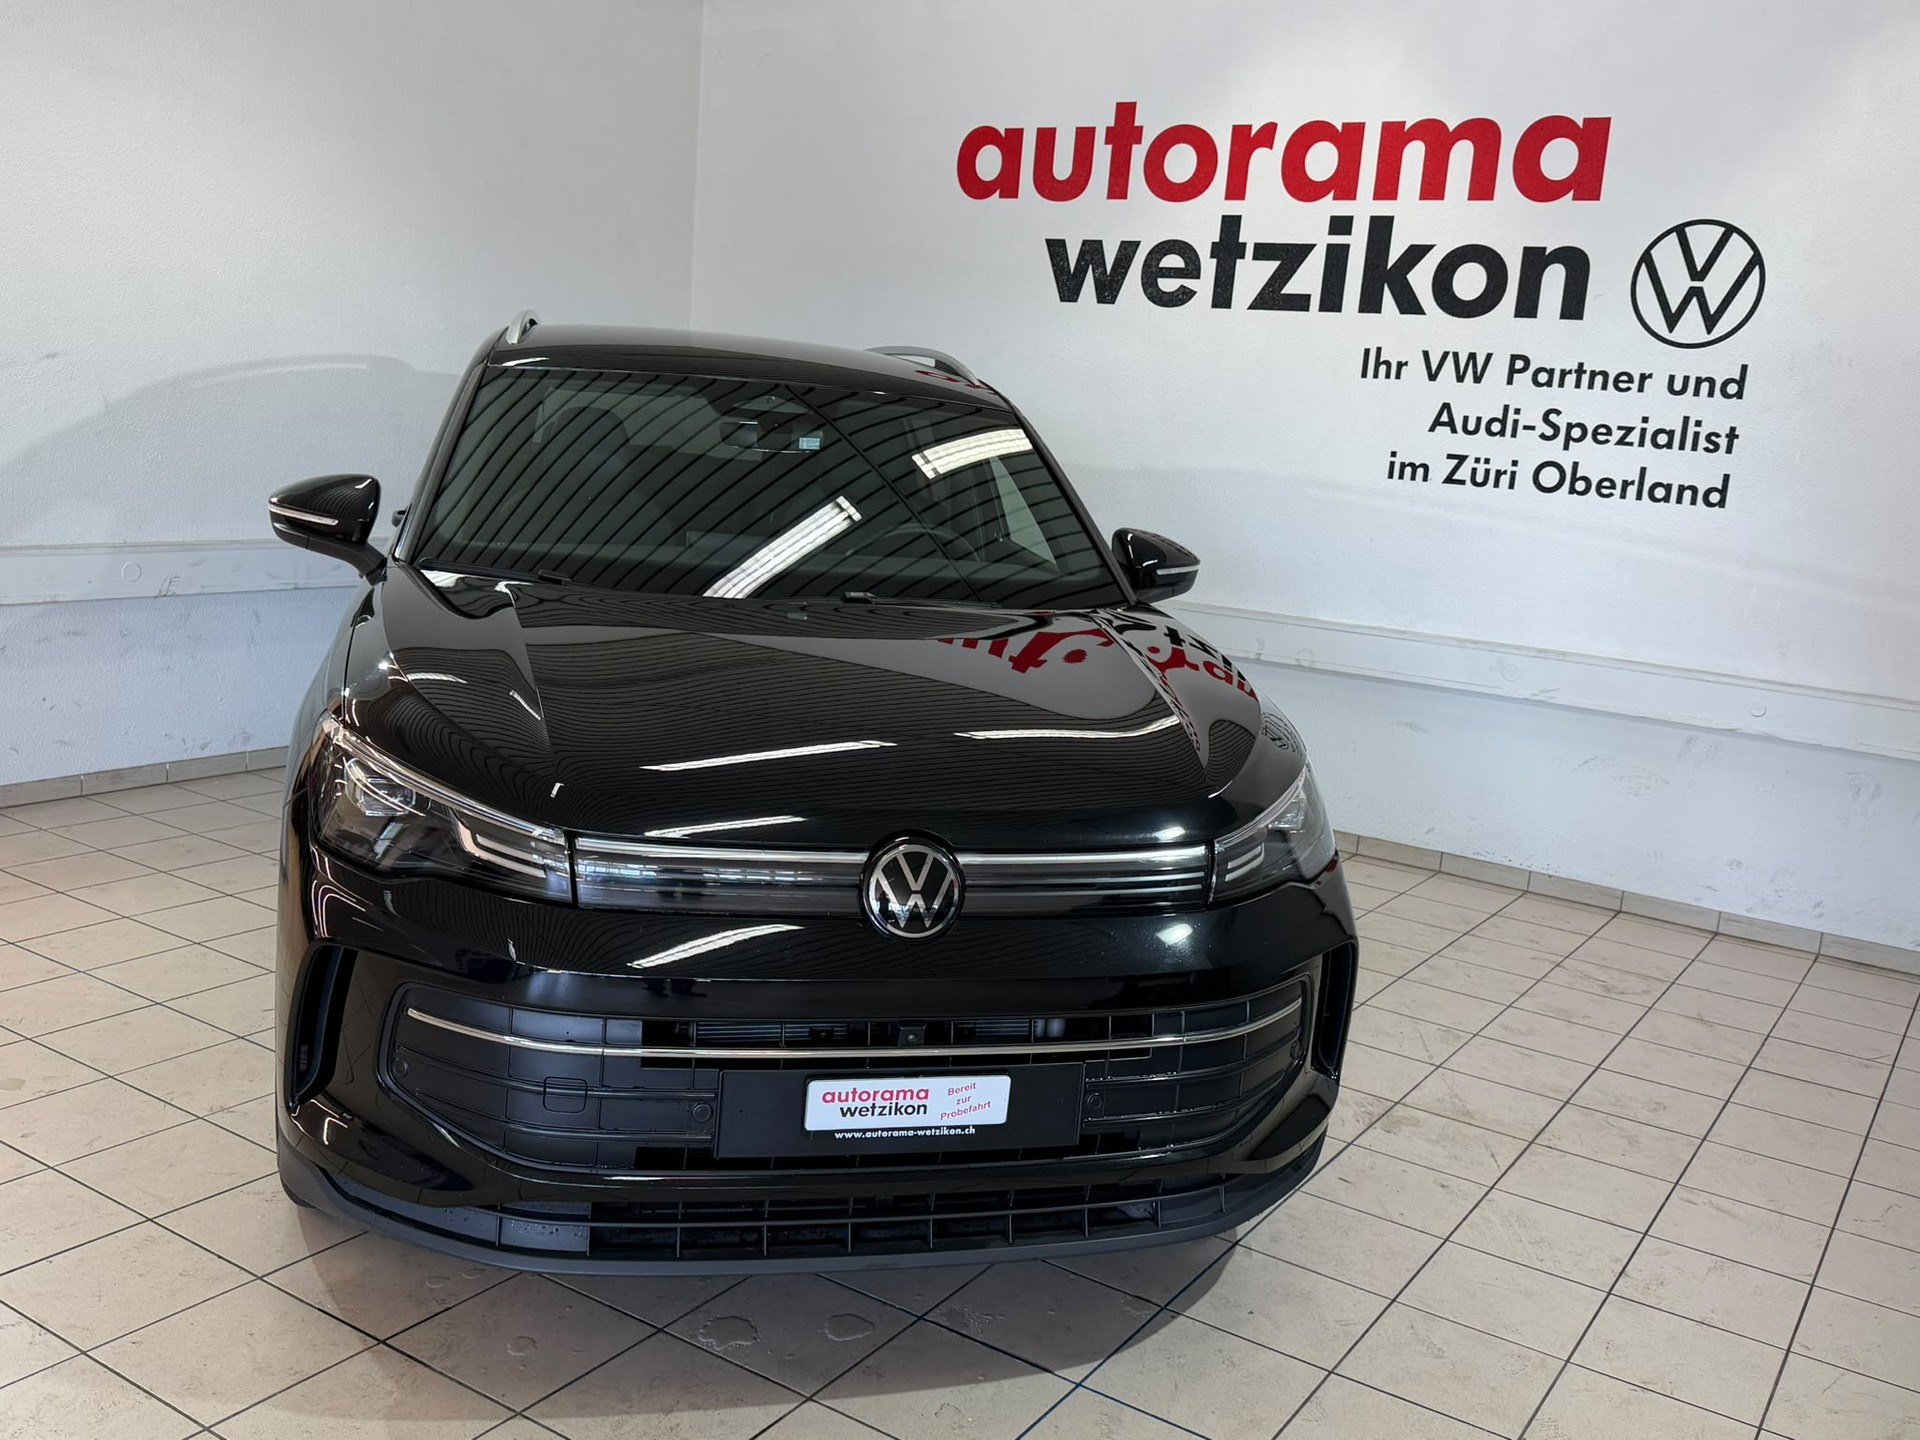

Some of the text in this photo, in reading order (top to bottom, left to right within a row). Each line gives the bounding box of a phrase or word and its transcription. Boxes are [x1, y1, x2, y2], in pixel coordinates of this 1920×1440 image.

[958, 102, 1611, 203] autorama
[1045, 215, 1590, 320] wetzikon
[1361, 347, 1748, 400] Ihr VW Partner und
[1428, 403, 1739, 454] Audi-Spezialist
[1388, 451, 1730, 508] im Züri Oberland
[822, 1087, 929, 1104] autorama
[947, 1082, 976, 1096] Bereit
[840, 1102, 927, 1118] wetzikon
[956, 1095, 972, 1105] zur
[940, 1101, 991, 1121] Probefahrt
[834, 1125, 976, 1139] www.autorama-wetzikon.ch
